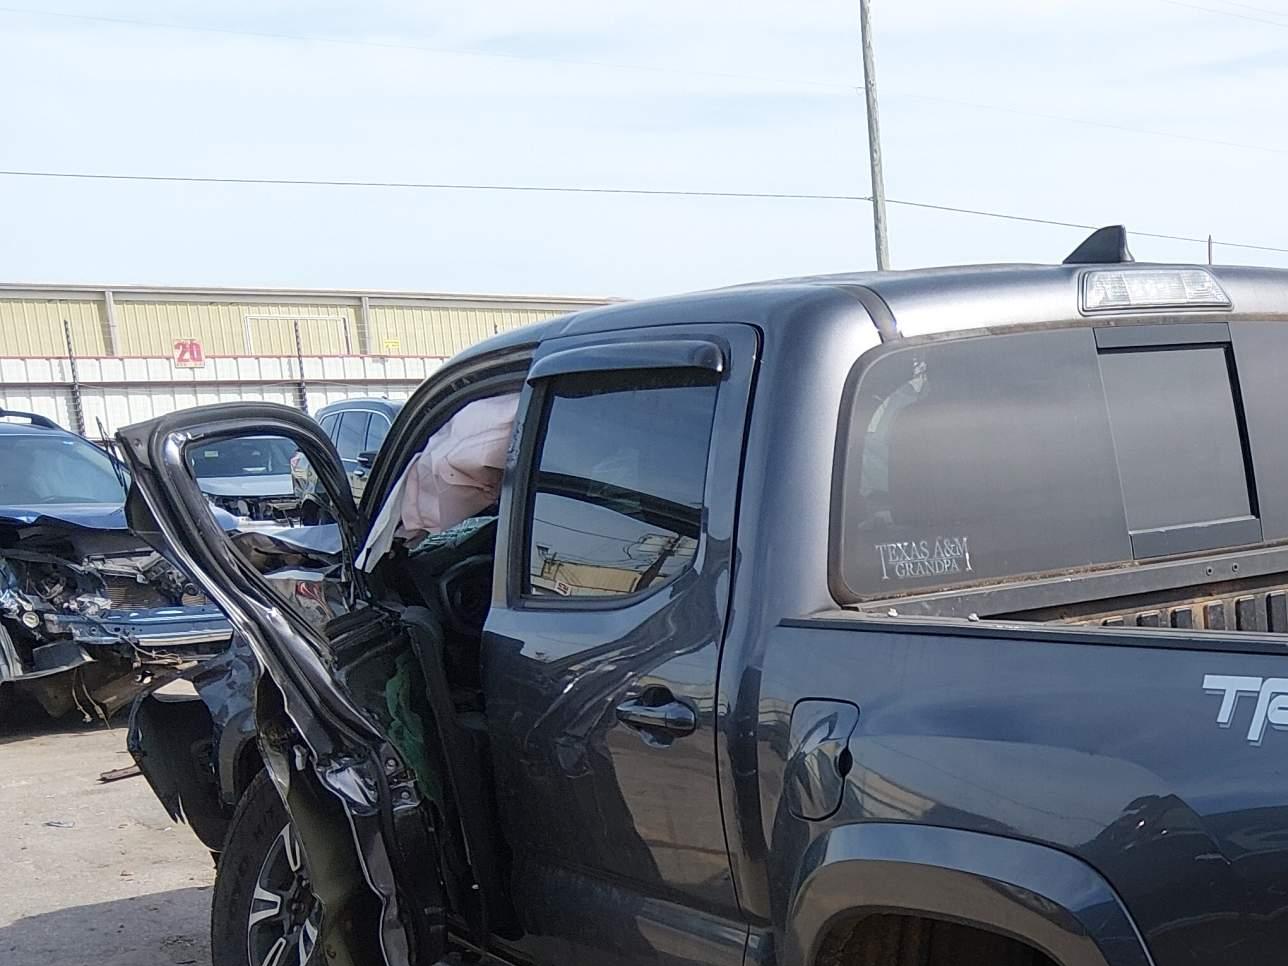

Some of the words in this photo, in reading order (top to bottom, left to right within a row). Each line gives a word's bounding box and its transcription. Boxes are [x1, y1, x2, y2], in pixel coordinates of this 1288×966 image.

[174, 342, 203, 362] 20
[874, 541, 930, 579] TEXAS
[933, 536, 973, 572] A&M
[895, 558, 960, 577] GRANDPA
